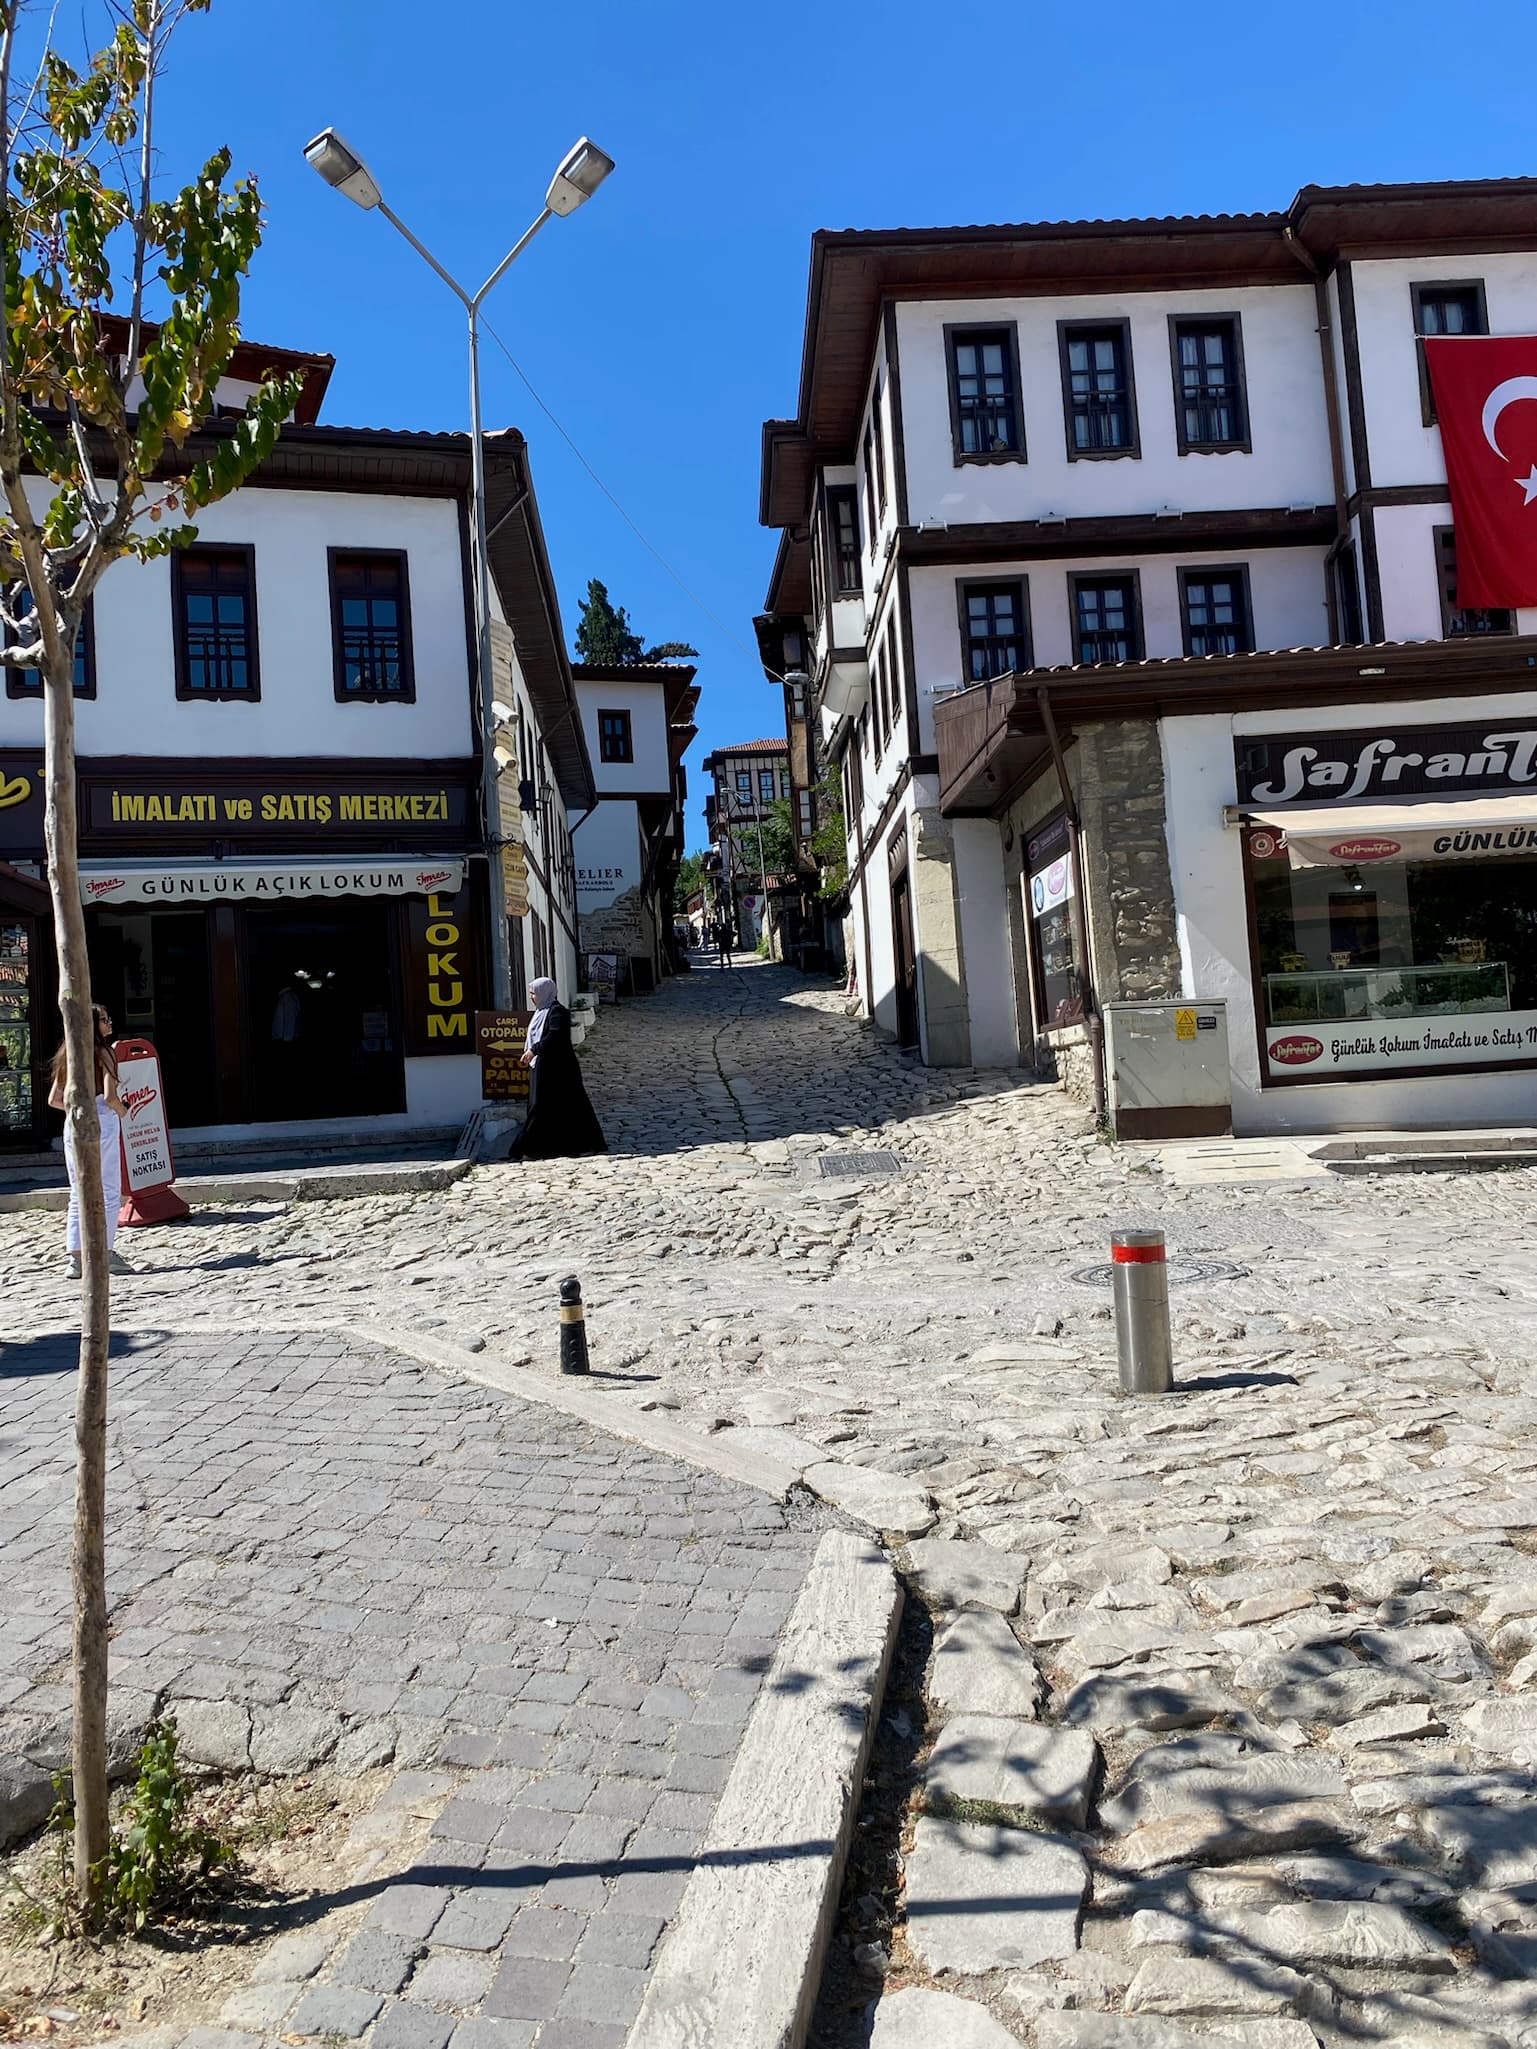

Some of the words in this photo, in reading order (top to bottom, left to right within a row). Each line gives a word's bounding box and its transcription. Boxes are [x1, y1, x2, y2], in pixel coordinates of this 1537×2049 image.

[1251, 731, 1537, 803] SafranT
[112, 791, 216, 821] İMALATI
[224, 799, 253, 820] ve
[261, 795, 332, 824] SATIŞ
[339, 790, 448, 820] MERKEZİ
[578, 868, 624, 879] ELIER
[142, 876, 246, 894] GÜNLÜK
[255, 876, 312, 895] AÇIK
[320, 874, 404, 889] LOKUM
[425, 894, 467, 1038] LOKUM
[496, 1017, 518, 1026] ÇARŞI
[481, 1027, 527, 1038] OTOPAR
[1331, 1037, 1376, 1062] Günlük
[1379, 1035, 1421, 1057] Lokum
[1423, 1028, 1473, 1050] İmalatı
[1474, 1035, 1489, 1047] ve
[1491, 1028, 1523, 1049] Satış
[136, 1149, 157, 1163] SATIŞ
[132, 1160, 166, 1177] NOKTASI
